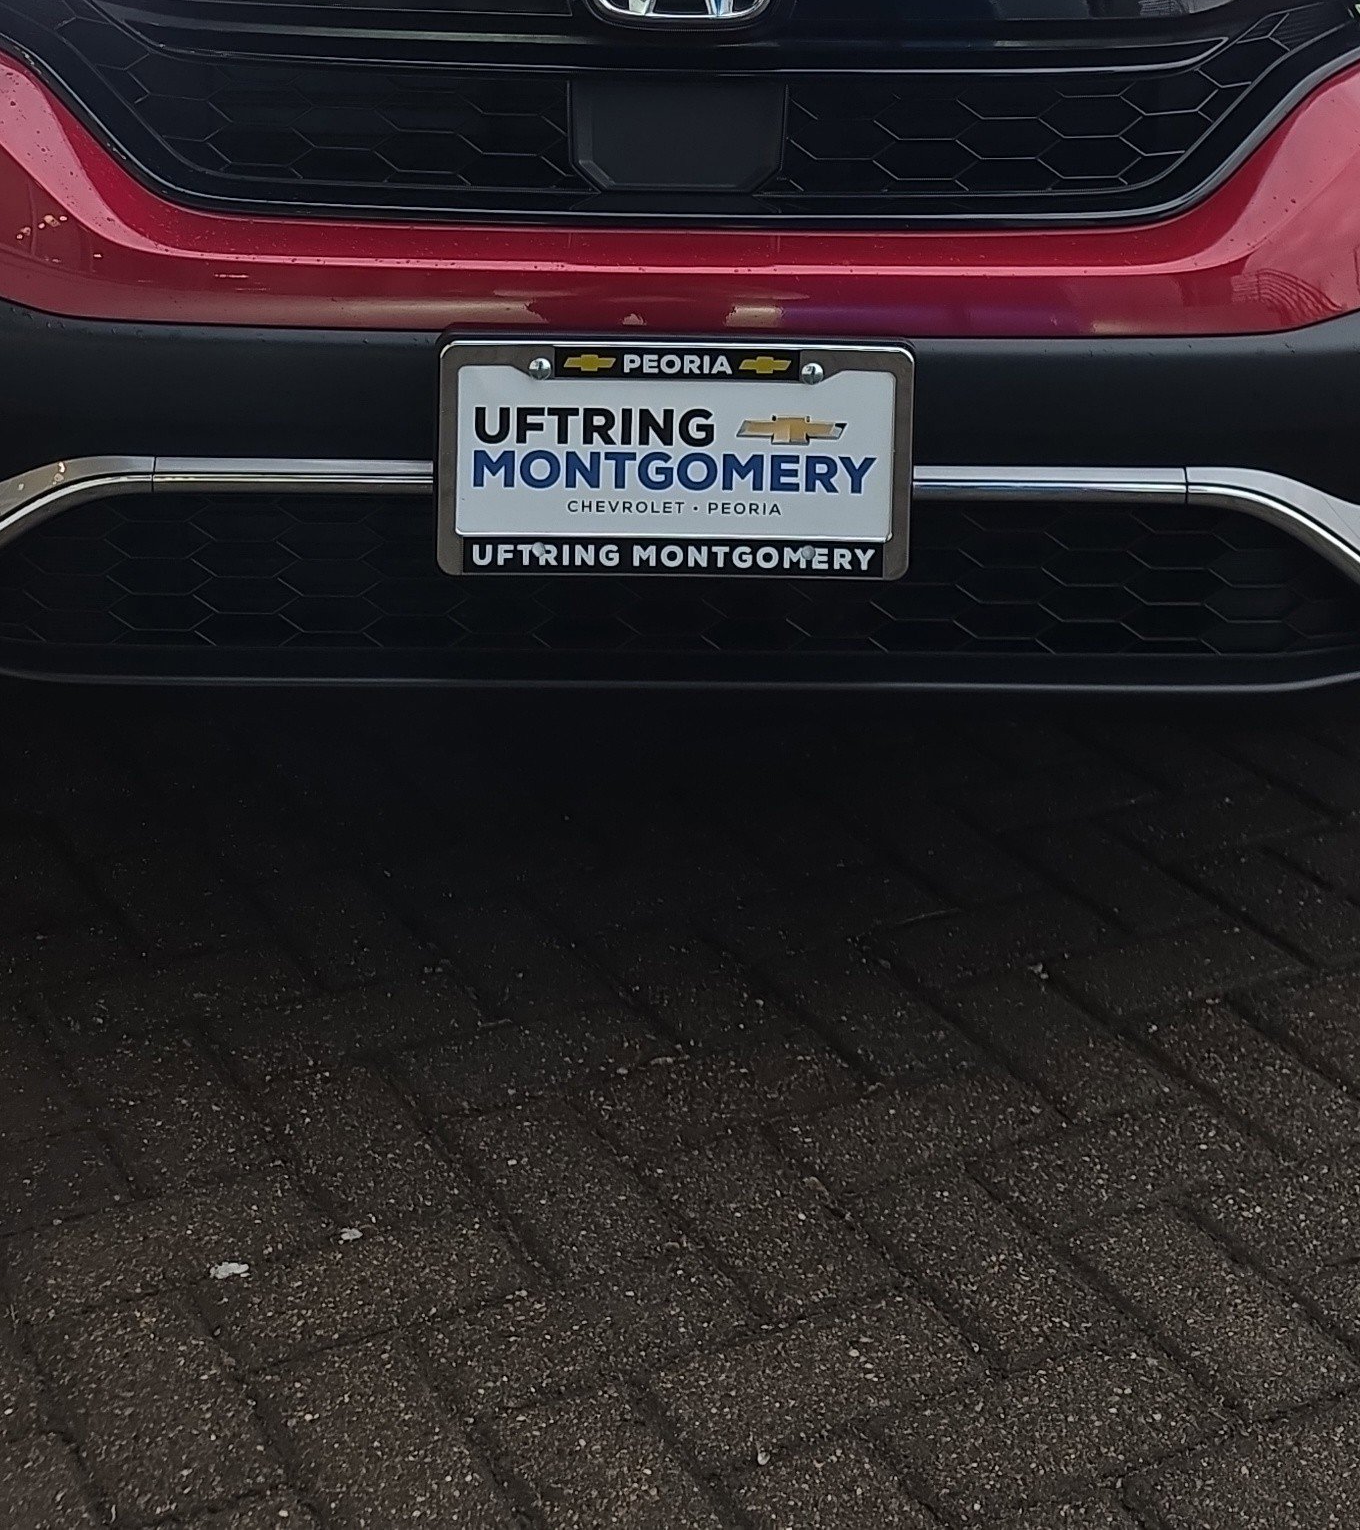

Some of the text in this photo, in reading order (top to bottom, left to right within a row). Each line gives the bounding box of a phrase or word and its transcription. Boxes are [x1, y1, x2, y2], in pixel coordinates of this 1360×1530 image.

[623, 353, 733, 375] PEORIA
[474, 407, 715, 447] UFTRING
[472, 450, 876, 494] MONTGOMERY
[567, 500, 782, 516] CHEVROLET PEORIA
[472, 544, 875, 571] UFTRING MONTGOMERY
